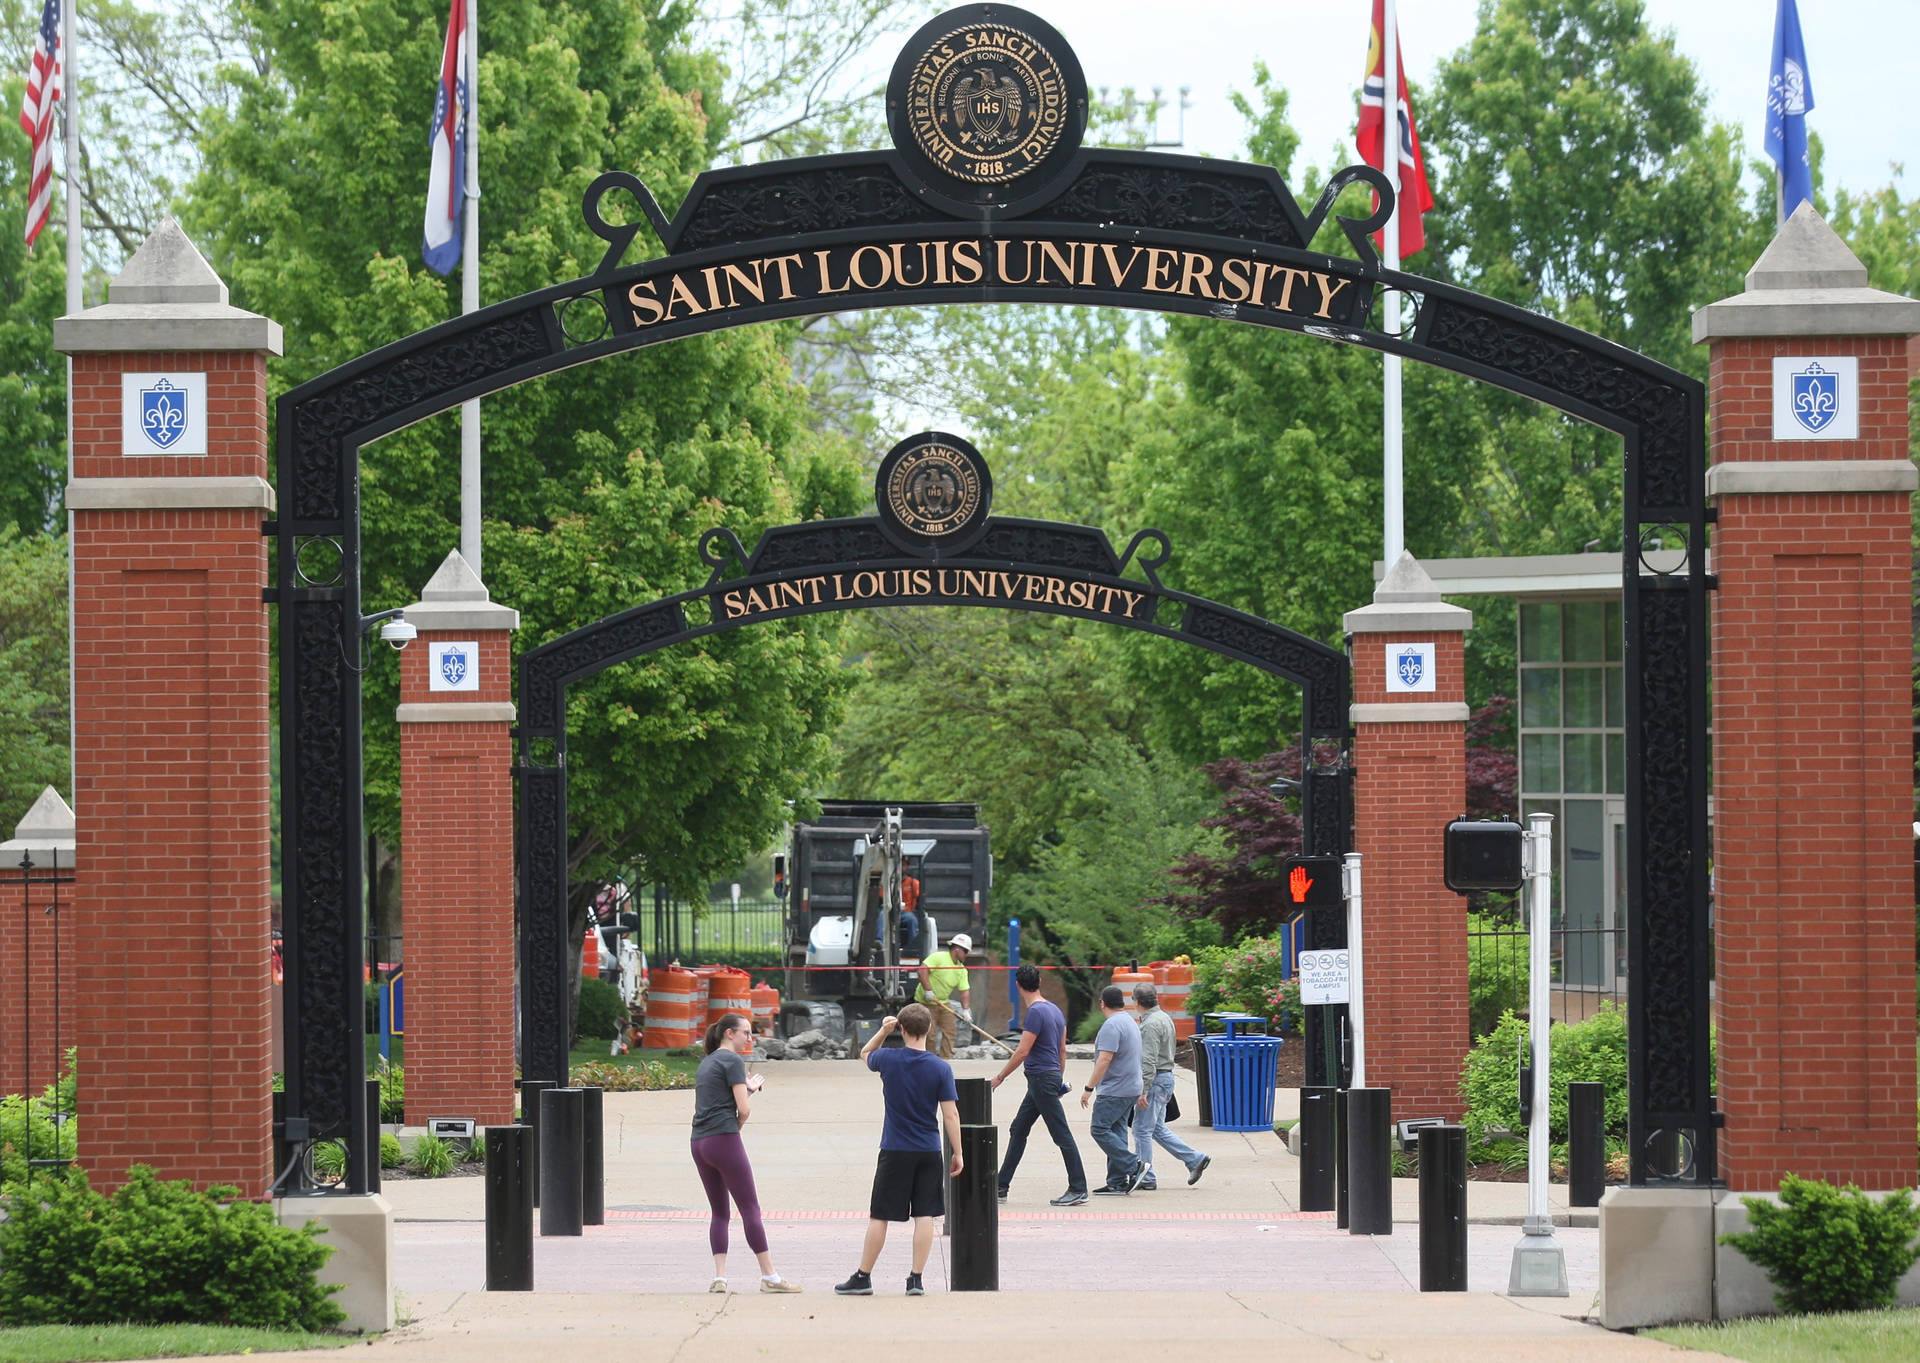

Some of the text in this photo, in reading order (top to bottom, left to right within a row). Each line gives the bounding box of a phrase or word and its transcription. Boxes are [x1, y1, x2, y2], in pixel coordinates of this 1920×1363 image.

[914, 31, 1059, 164] UNIVERSITAS SANCTI LUDOVICI
[938, 52, 1037, 107] RELIGIONI ET BONIS ARTIBUS
[976, 102, 1000, 114] IHS
[973, 161, 1004, 175] 1818
[627, 239, 1352, 328] SAINT LOUIS UNIVERSITY
[891, 455, 916, 525] UNIVERSITAS
[922, 447, 964, 466] SANCTI
[954, 469, 976, 525] LUDOVICI
[927, 489, 942, 497] IHS
[925, 523, 944, 532] 1818
[723, 569, 1144, 619] SAINT LOUIS UNIVERSITY
